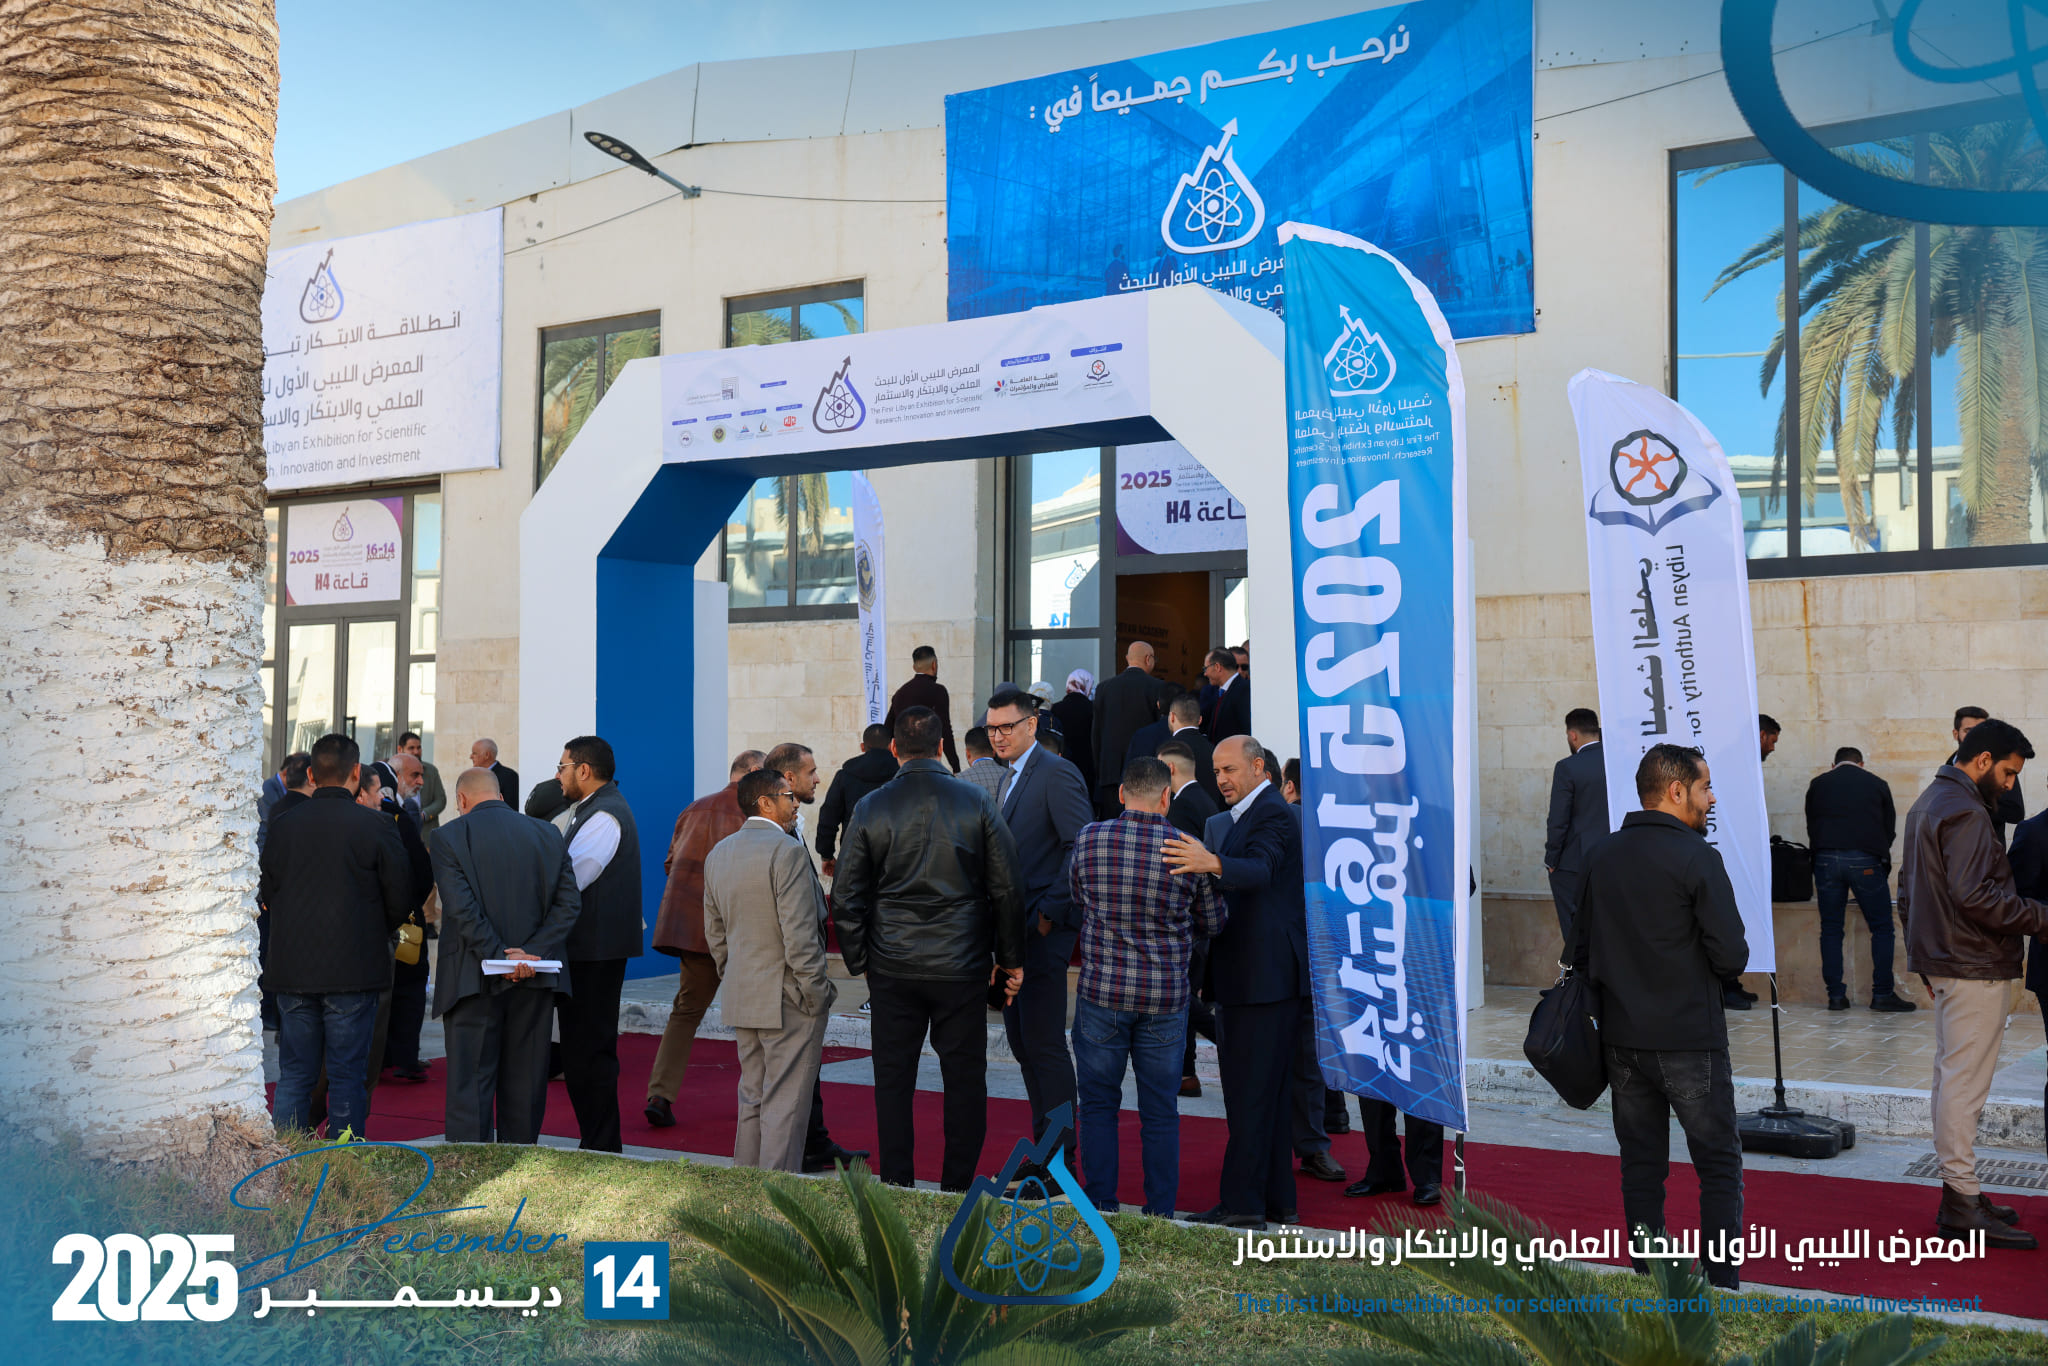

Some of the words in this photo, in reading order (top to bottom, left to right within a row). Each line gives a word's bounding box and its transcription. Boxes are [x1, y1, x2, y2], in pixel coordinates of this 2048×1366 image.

[1306, 24, 1410, 78] نرحب
[1199, 48, 1298, 103] بكم
[1119, 272, 1159, 292] للبحث
[1163, 263, 1198, 288] الأول
[1202, 260, 1247, 287] الليبي
[368, 311, 460, 340] انطلاقة
[304, 325, 363, 356] الابتكار
[275, 365, 309, 398] الأول
[313, 364, 358, 398] الليبي
[363, 354, 423, 386] المعرض
[874, 375, 898, 388] للبحث
[899, 369, 919, 386] الأول
[921, 368, 946, 384] الليبي
[948, 363, 980, 379] المعرض
[874, 389, 915, 404] والاستثمار
[916, 384, 949, 399] والابتكار
[951, 379, 981, 396] العلمي
[304, 398, 362, 427] والابتكار
[367, 389, 423, 424] العلمي
[266, 439, 300, 455] Libyan
[303, 432, 355, 450] Exhibition
[358, 430, 373, 444] for
[376, 422, 427, 441] Scientific
[280, 458, 334, 475] Innovation
[336, 454, 356, 470] and
[358, 448, 421, 467] Investment
[1121, 470, 1172, 490] 2025
[1166, 500, 1191, 524] H4
[1197, 498, 1246, 522] اعة
[289, 549, 320, 564] 2025
[315, 573, 330, 591] H4
[333, 572, 368, 590] قاعة
